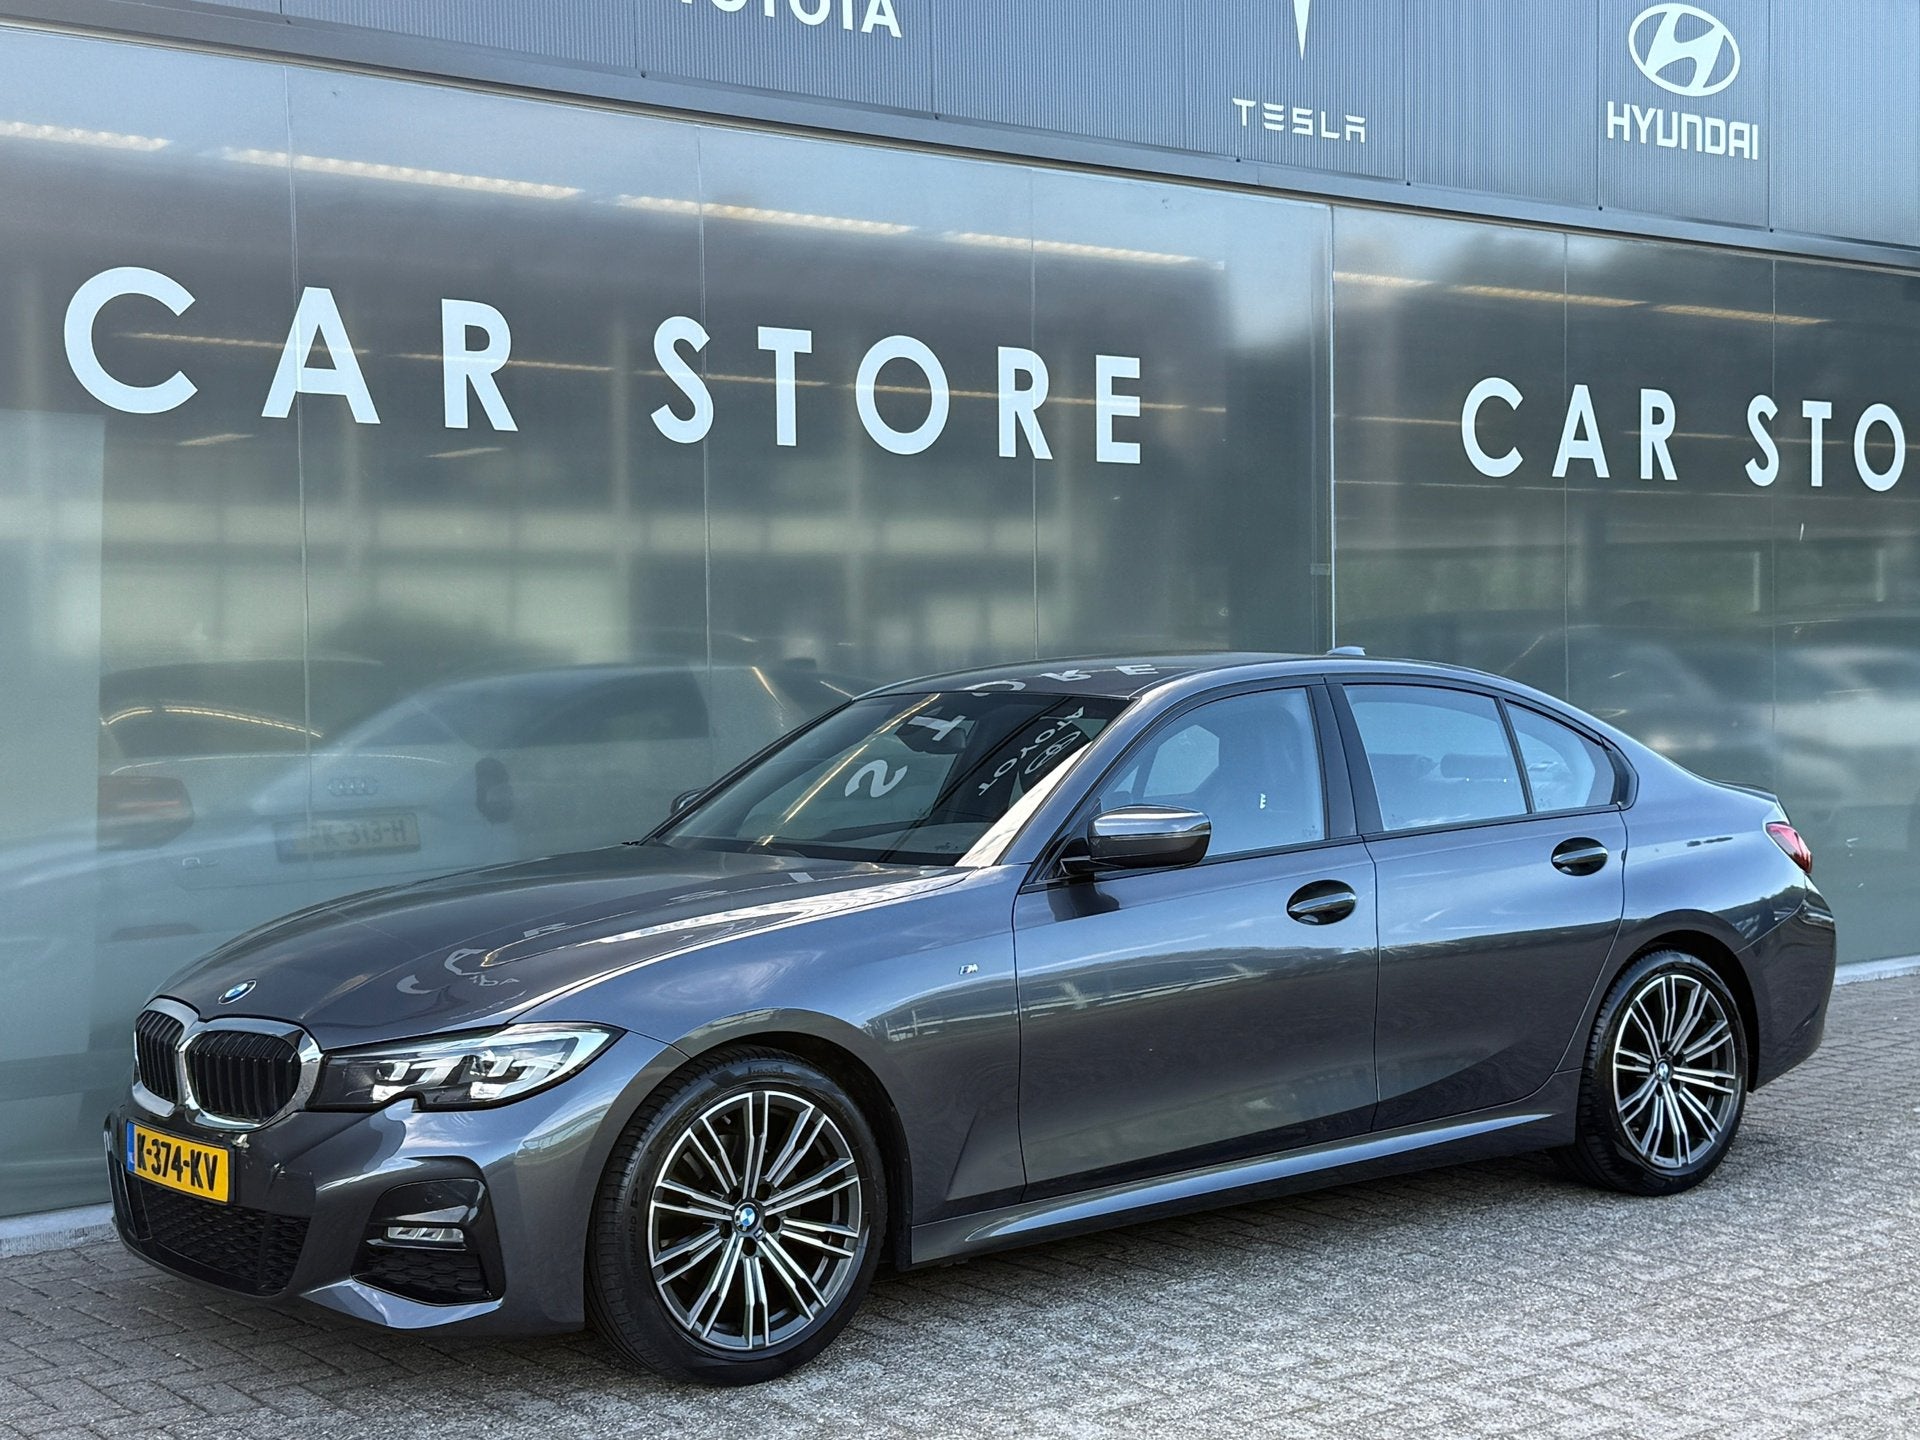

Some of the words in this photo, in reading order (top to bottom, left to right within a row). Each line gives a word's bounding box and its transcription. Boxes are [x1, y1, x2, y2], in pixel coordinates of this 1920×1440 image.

[1232, 97, 1367, 144] TESLA
[1606, 100, 1760, 161] HYUNDAI
[64, 266, 518, 432] CAR
[650, 316, 1142, 465] STORE
[1461, 377, 1678, 481] CAR
[1745, 394, 1906, 492] STO
[136, 1132, 219, 1192] K-374-KV
